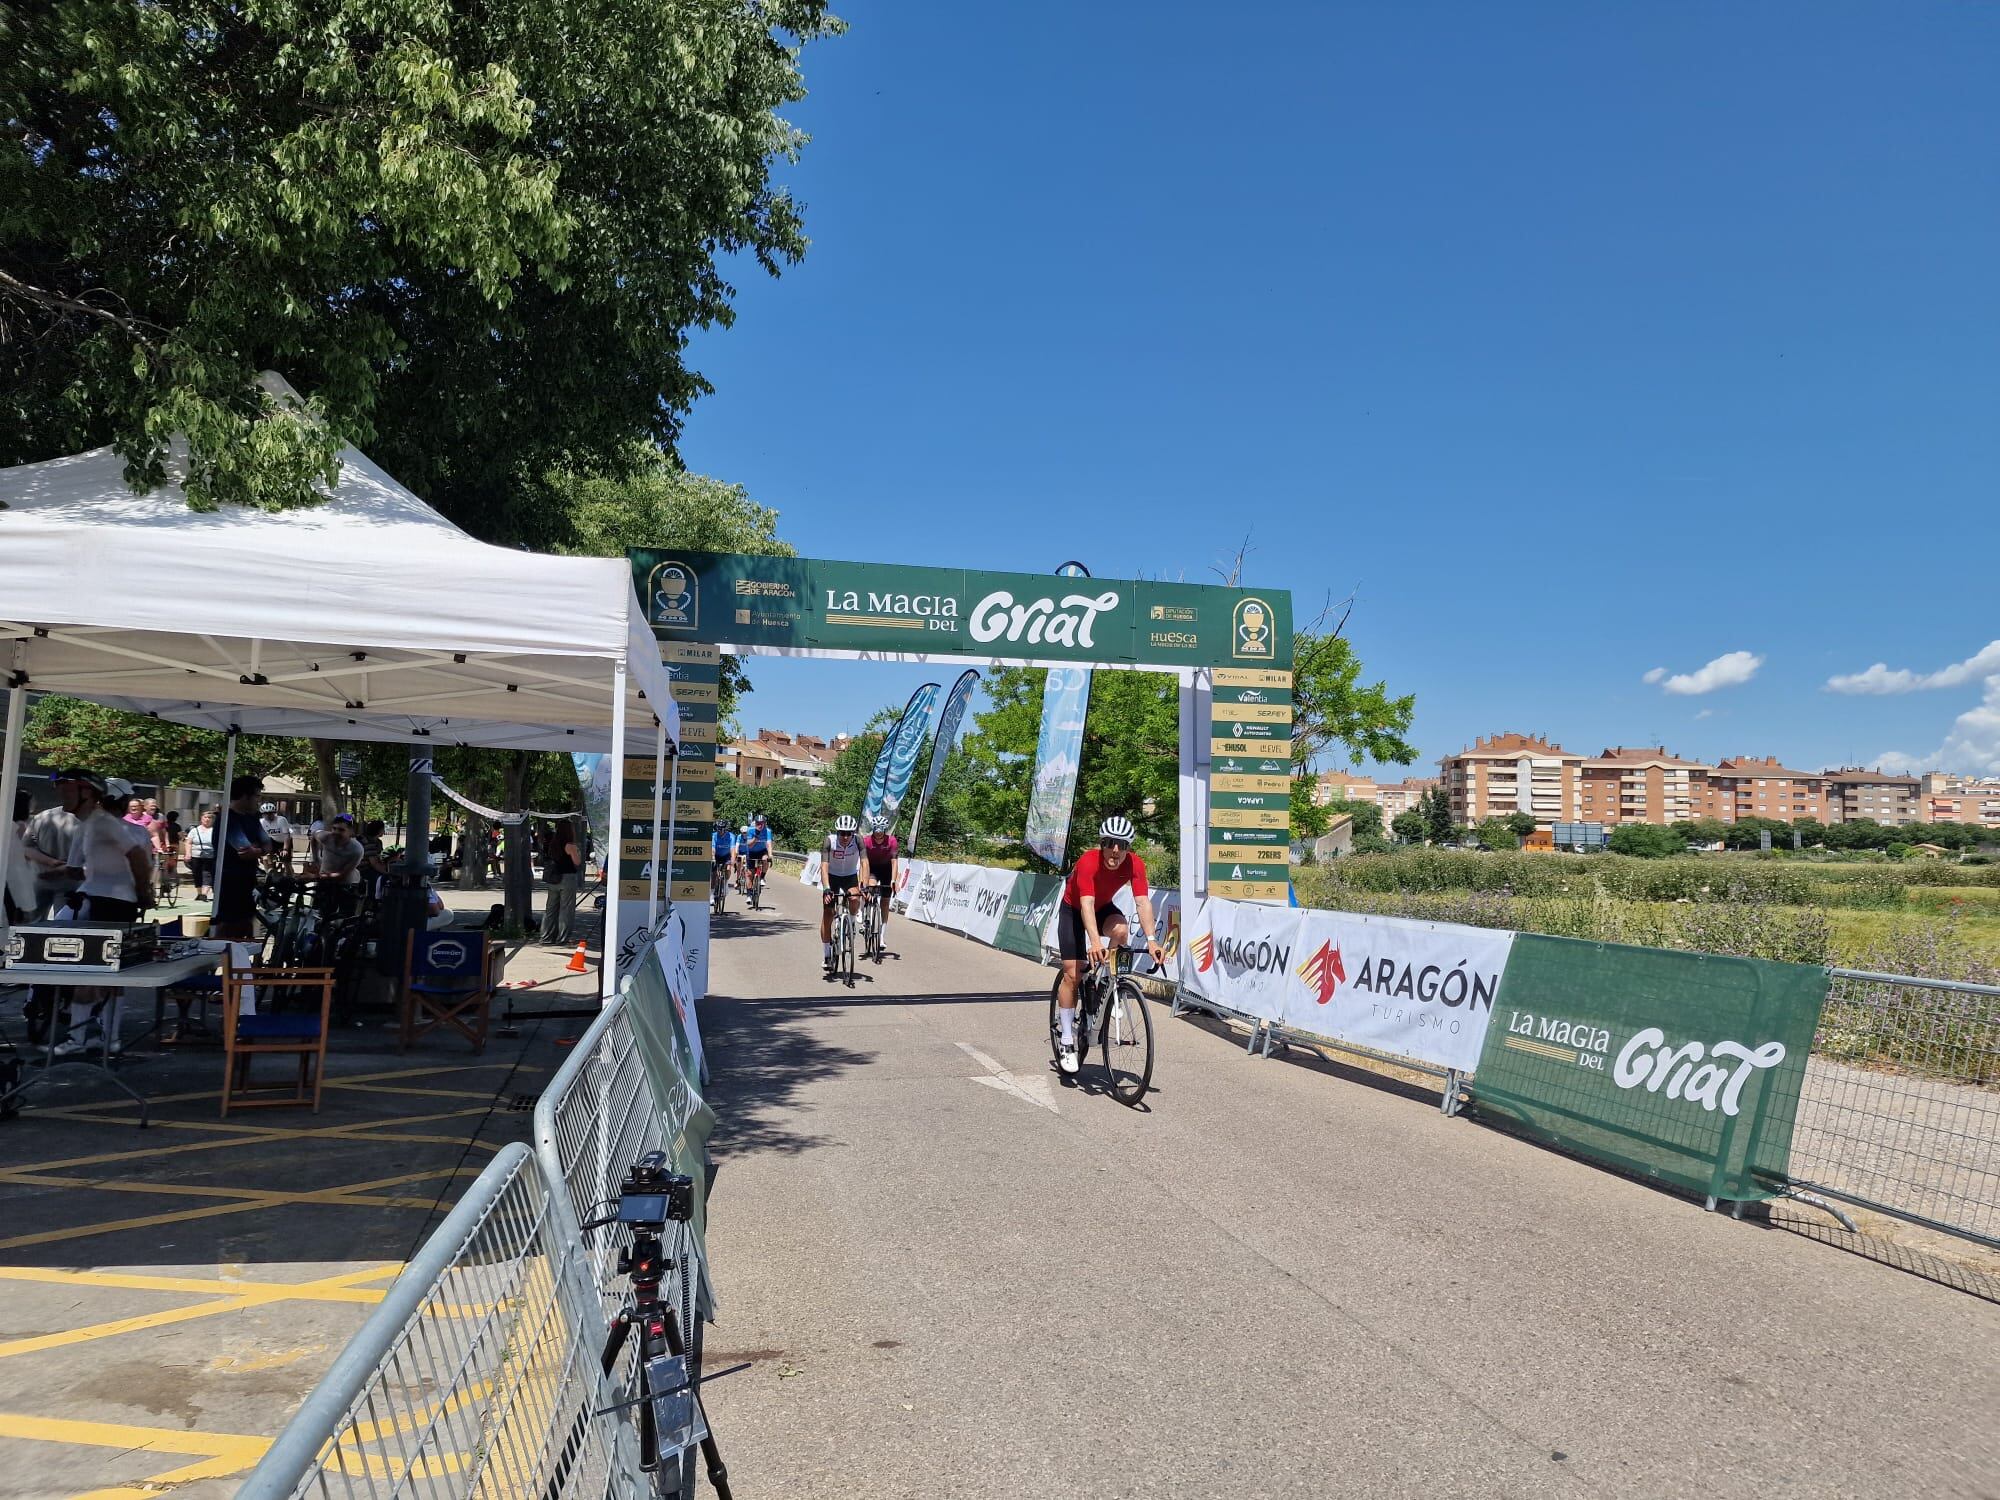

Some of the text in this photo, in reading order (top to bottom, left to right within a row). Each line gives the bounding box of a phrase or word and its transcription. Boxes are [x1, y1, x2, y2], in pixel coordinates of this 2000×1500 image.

[750, 581, 790, 590] GOBIERNO
[751, 610, 801, 620] Ayuntamiento
[762, 618, 790, 627] Huesca
[668, 671, 689, 680] entia
[1265, 675, 1287, 683] MILAR
[675, 688, 712, 697] SERFEY
[1238, 692, 1268, 703] Valentia
[1256, 709, 1287, 718] SERFEY
[674, 846, 703, 856] 226ERS
[1257, 850, 1282, 859] 226ERS
[1215, 934, 1291, 977] ARAGÓN
[1353, 958, 1498, 1013] ARAGÓN
[1372, 1003, 1462, 1035] TURISMO
